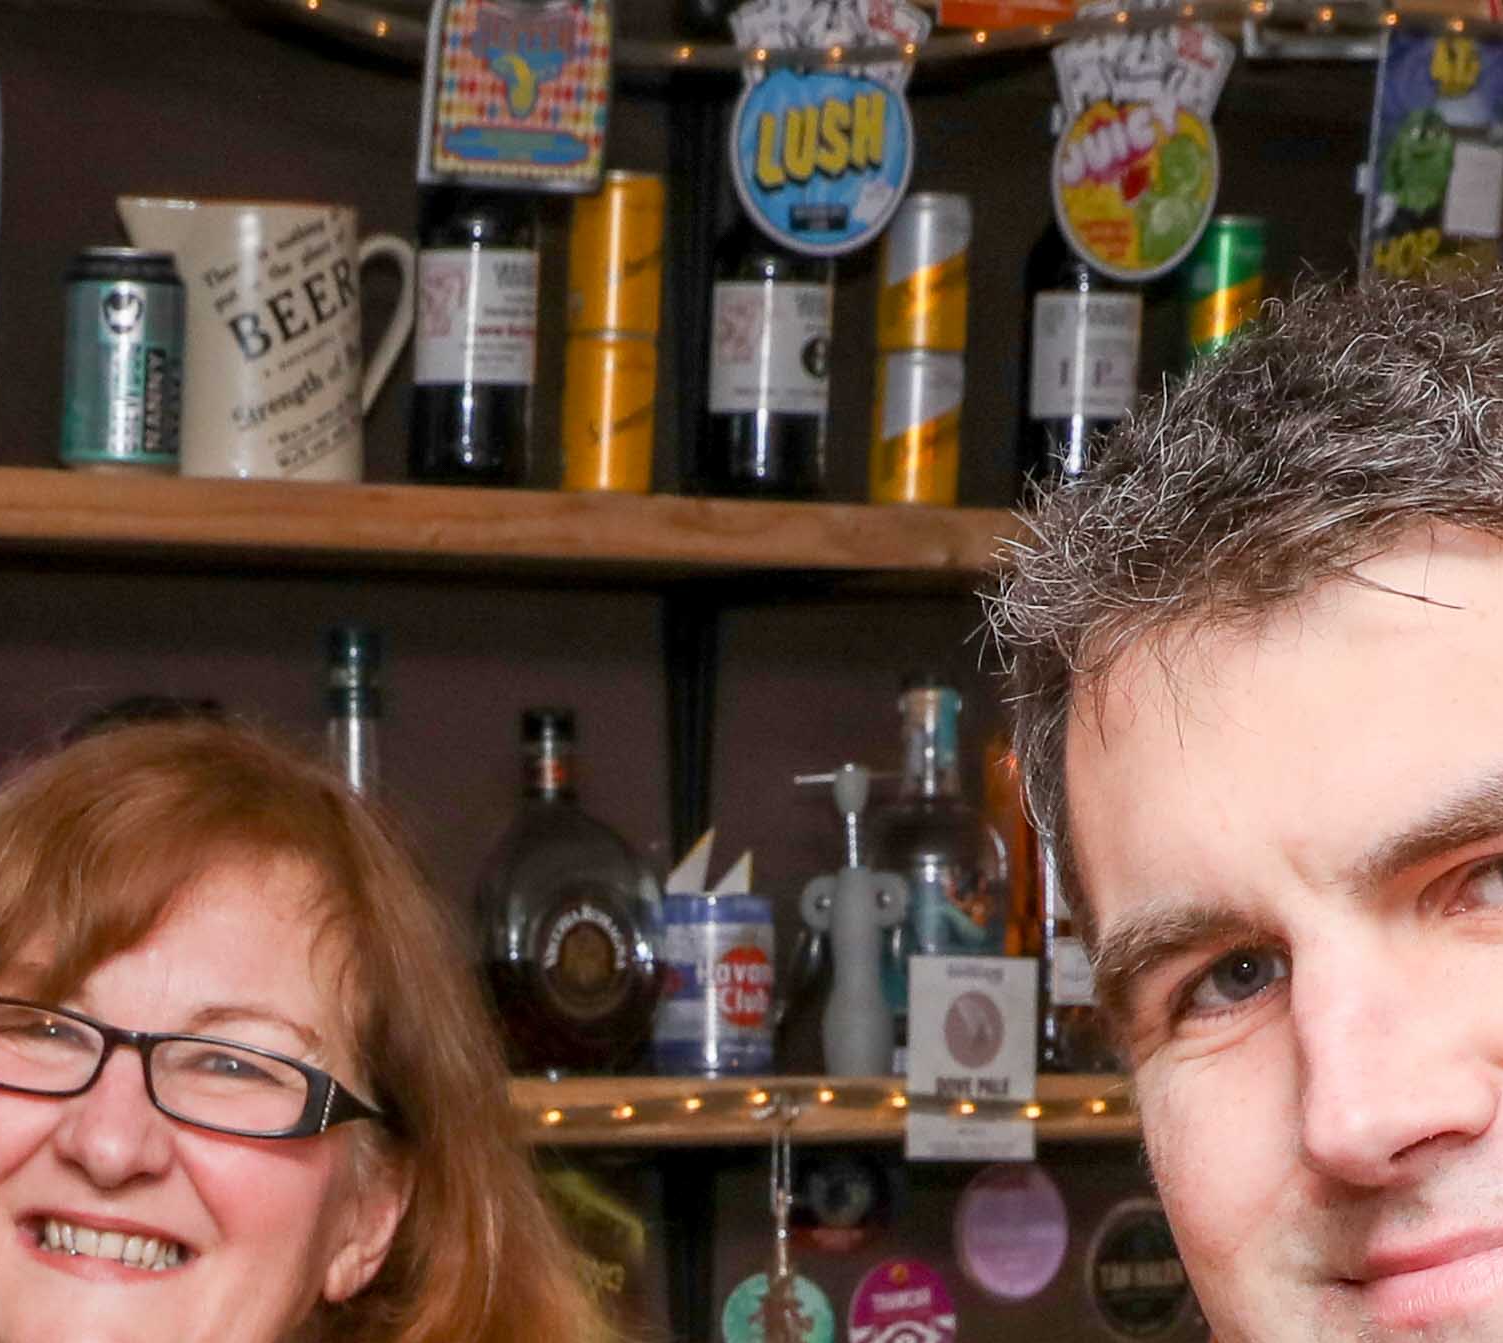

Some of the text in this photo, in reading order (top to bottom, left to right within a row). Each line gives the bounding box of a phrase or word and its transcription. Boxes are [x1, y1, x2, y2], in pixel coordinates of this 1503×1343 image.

[754, 90, 886, 193] LUSH
[228, 258, 357, 361] BEER
[233, 372, 325, 433] Strength
